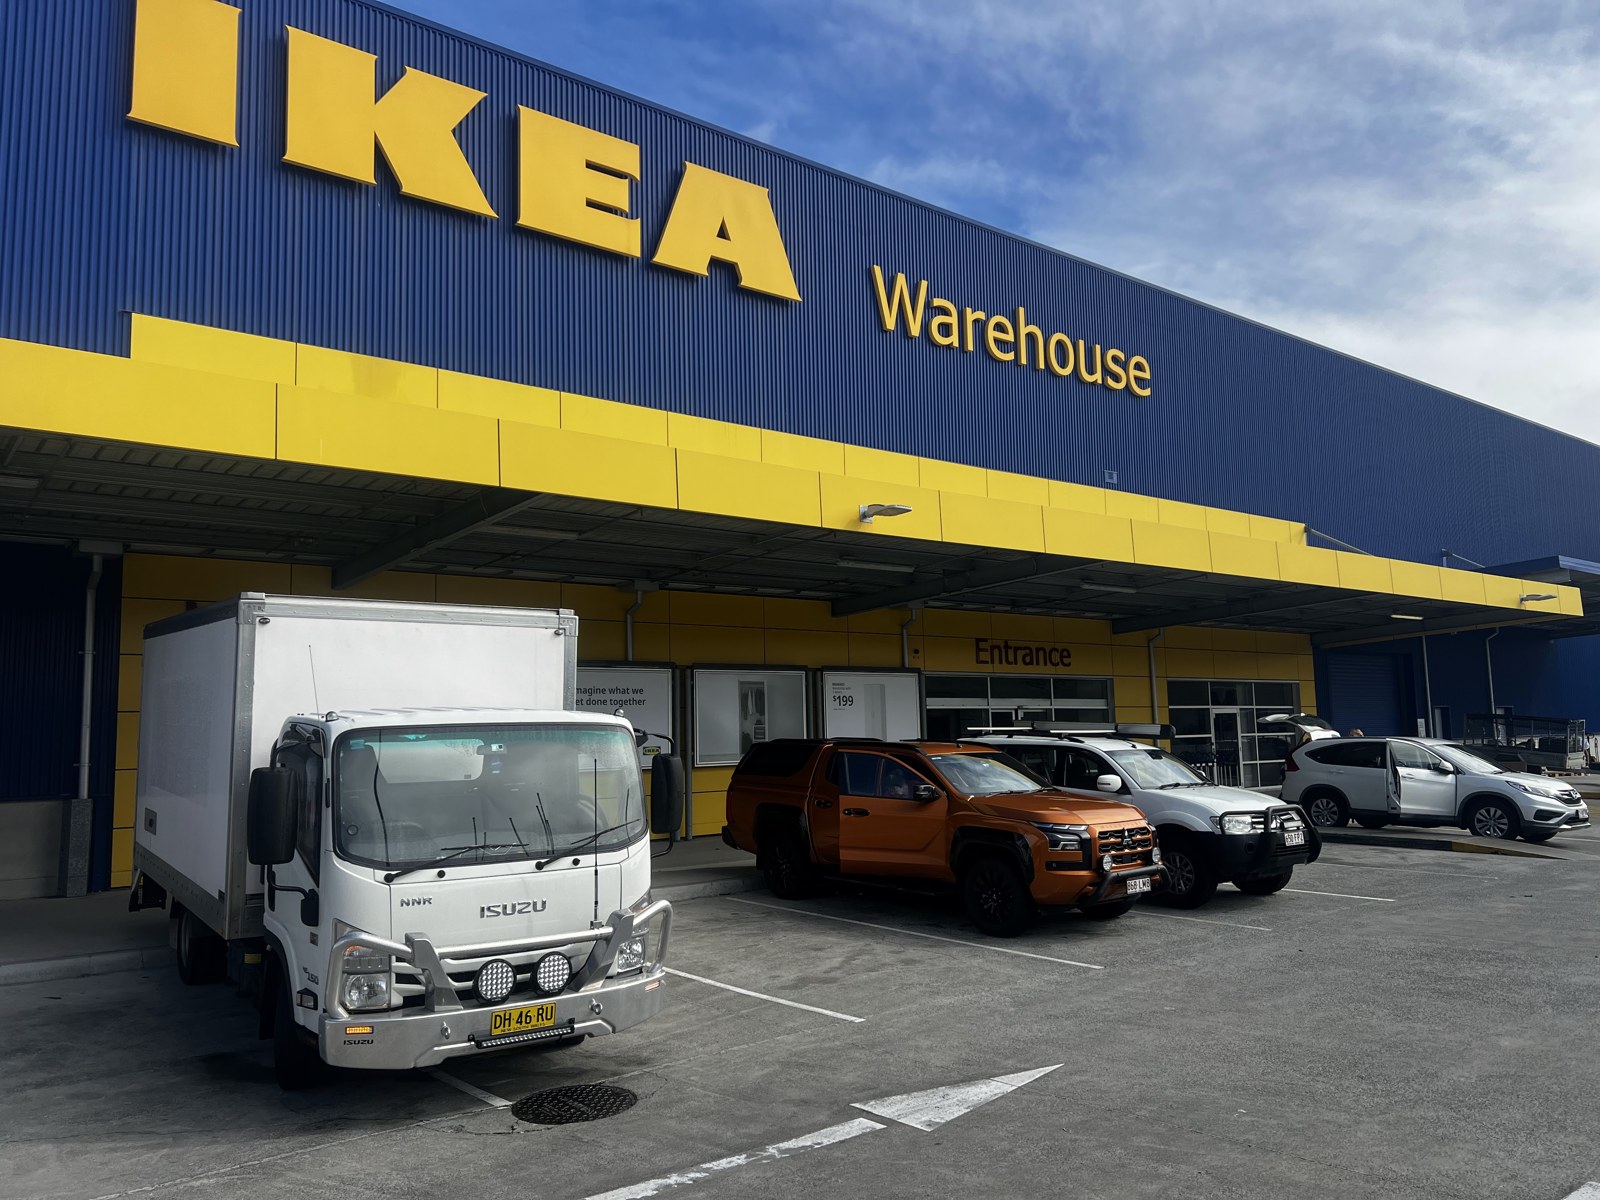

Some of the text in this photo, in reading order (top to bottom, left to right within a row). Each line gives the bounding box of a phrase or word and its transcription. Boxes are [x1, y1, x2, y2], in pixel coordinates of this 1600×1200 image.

[126, 0, 802, 302] IKEA
[870, 264, 1152, 398] Warehouse
[975, 637, 1072, 667] Entrance
[576, 686, 607, 697] magine
[608, 686, 630, 695] what
[575, 697, 647, 708] et done together
[832, 695, 854, 707] $199
[400, 897, 433, 908] NNR
[479, 898, 547, 919] ISUZU
